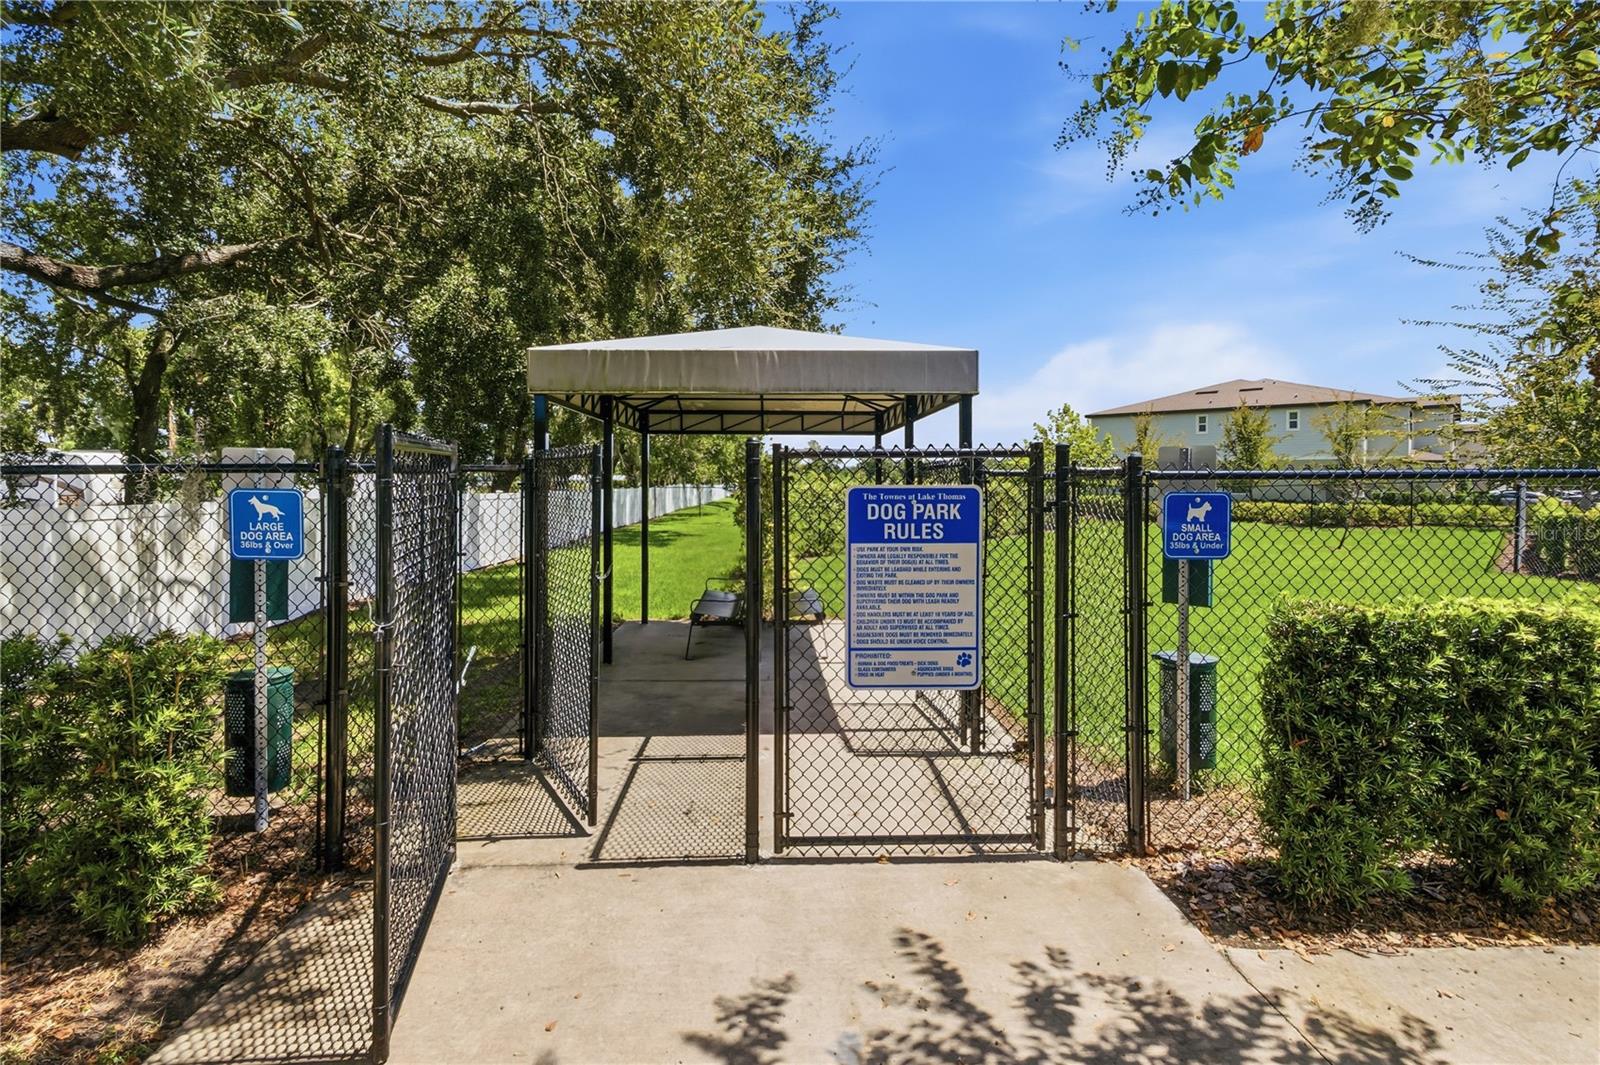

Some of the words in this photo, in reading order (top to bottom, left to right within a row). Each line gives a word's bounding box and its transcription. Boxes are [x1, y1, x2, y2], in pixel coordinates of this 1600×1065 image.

[868, 503, 905, 520] DOG
[913, 503, 961, 520] PARK
[250, 522, 284, 531] LARGE
[884, 523, 944, 539] RULES
[240, 532, 262, 540] DOG
[266, 532, 293, 540] AREA
